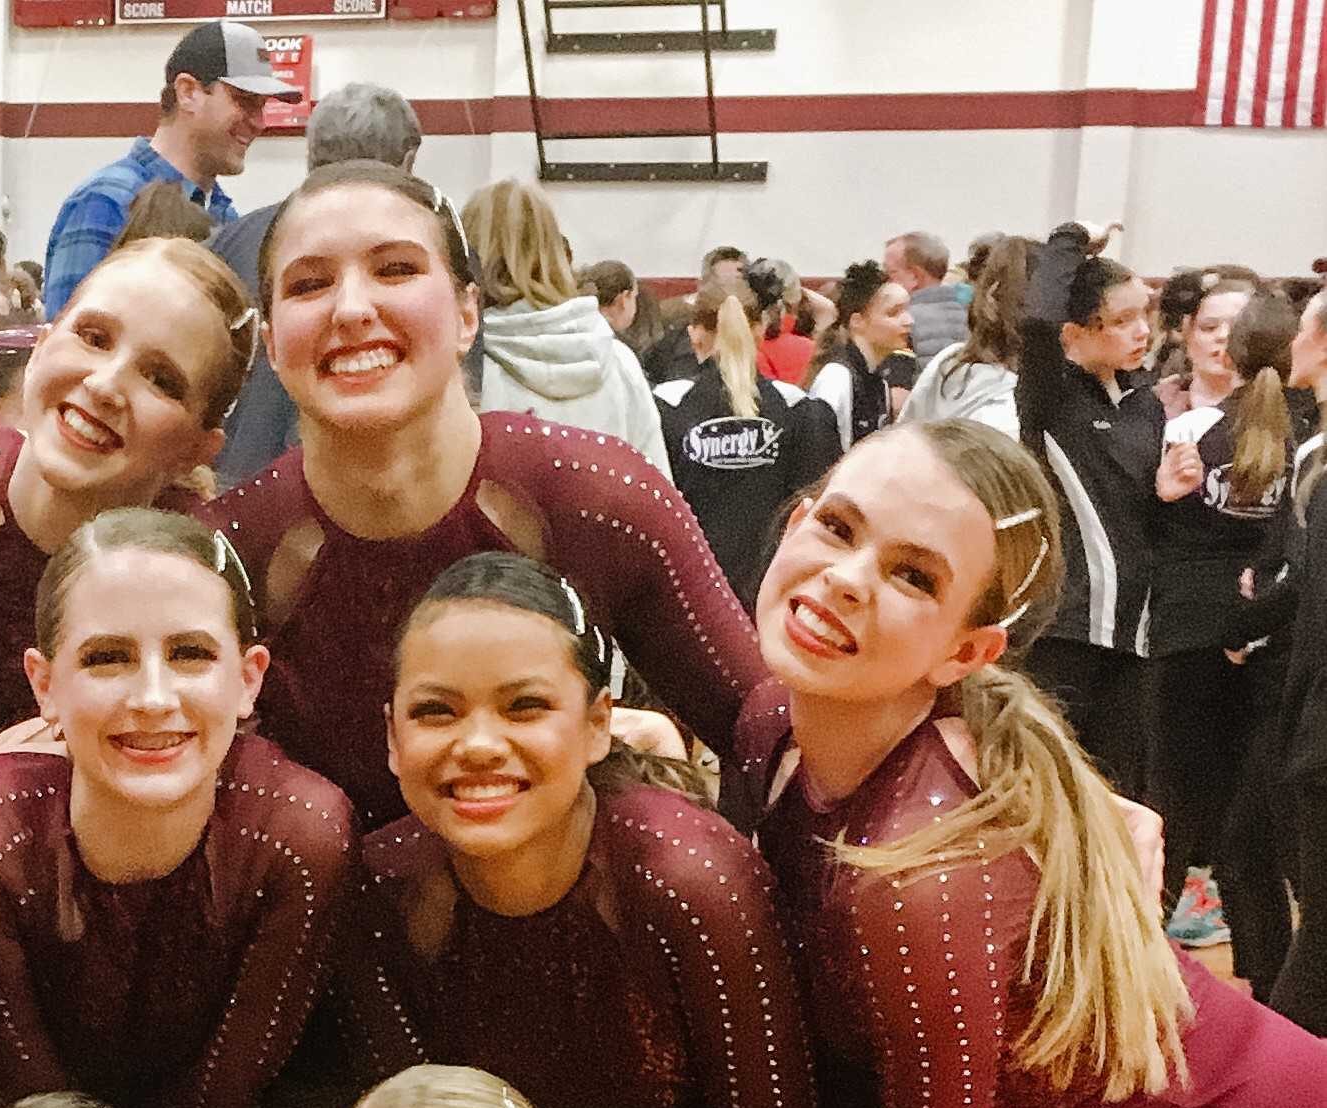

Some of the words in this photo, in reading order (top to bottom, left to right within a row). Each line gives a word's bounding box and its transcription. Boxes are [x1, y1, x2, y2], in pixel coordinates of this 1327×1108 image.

[124, 2, 165, 18] SCORE
[226, 0, 273, 14] MATCH
[334, 0, 376, 13] SCORE
[264, 37, 303, 52] OOK
[688, 425, 759, 463] Synergy
